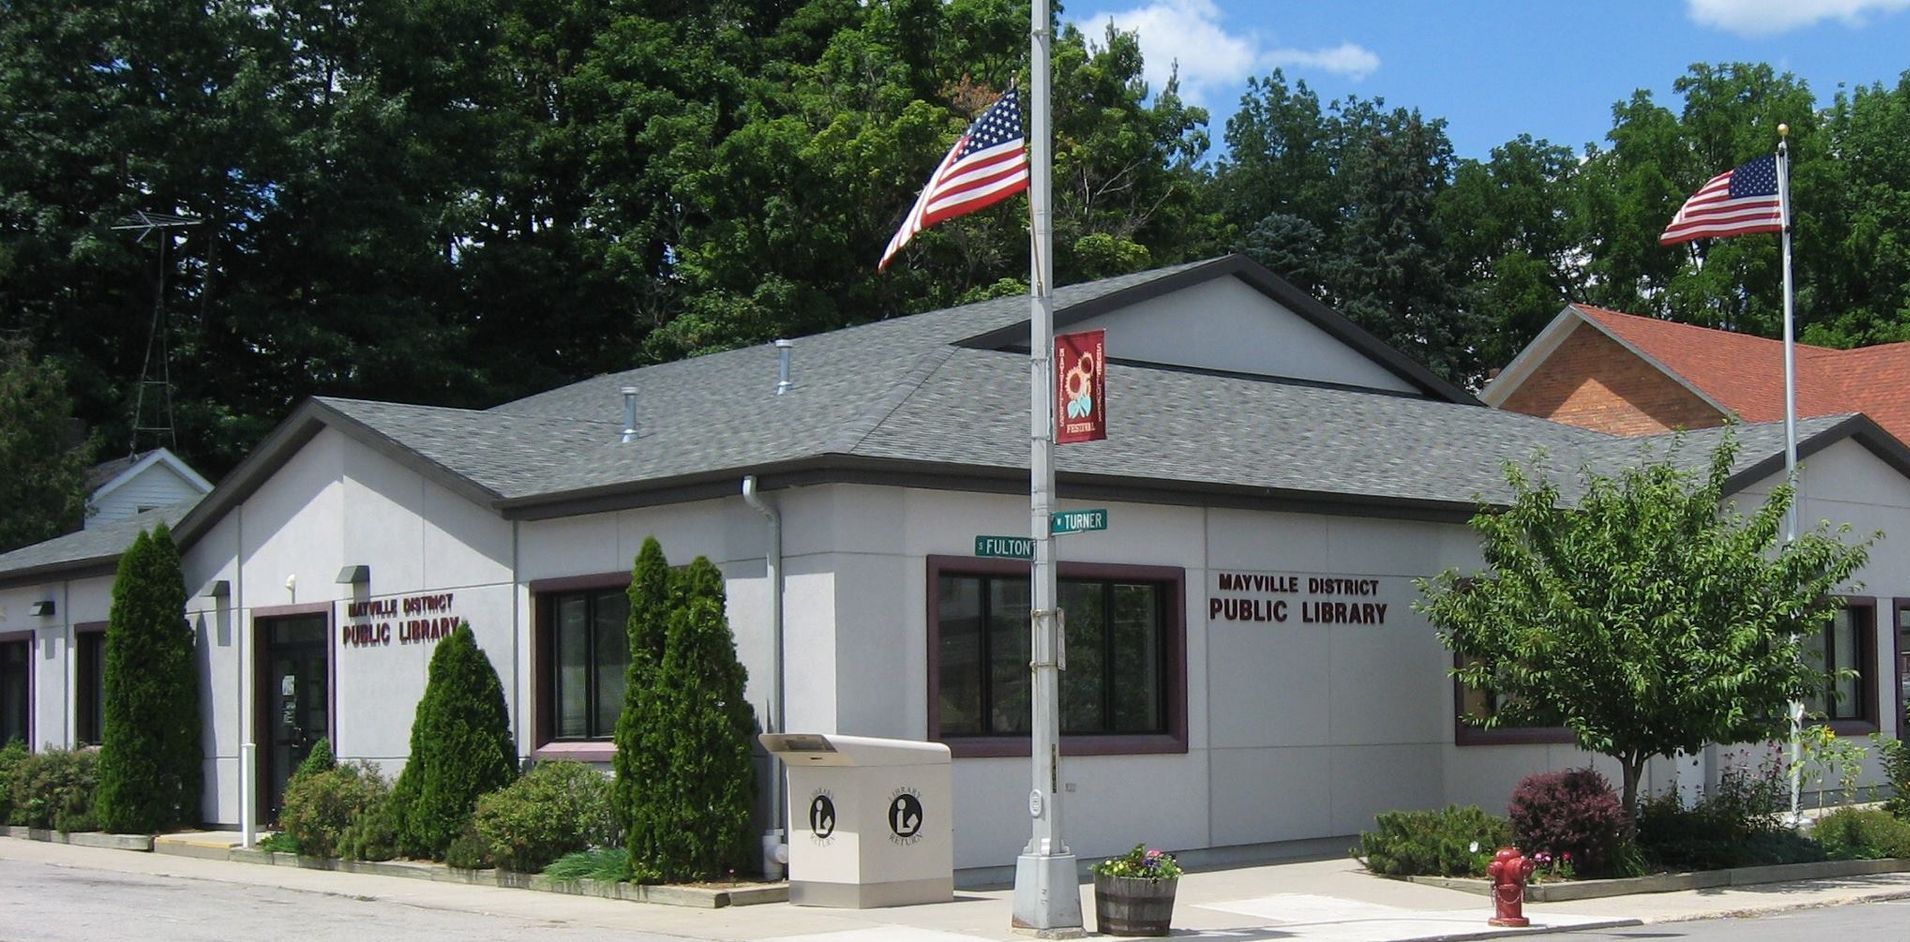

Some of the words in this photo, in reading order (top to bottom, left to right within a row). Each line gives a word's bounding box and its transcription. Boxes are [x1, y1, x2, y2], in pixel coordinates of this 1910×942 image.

[1066, 422, 1096, 434] FESTIVAL
[1064, 512, 1102, 530] TURNER
[978, 541, 983, 550] S
[986, 539, 1030, 555] FULTON
[1219, 573, 1299, 593] MAYVILLE
[1308, 577, 1379, 596] DISTRICT
[348, 599, 398, 618] MAYVILLE
[403, 593, 454, 614] DISTRICT
[1209, 598, 1288, 623] PUBLIC
[1302, 601, 1387, 625] LIBRARY
[342, 622, 391, 646] PUBLIC
[398, 616, 460, 642] LIBRARY
[888, 786, 923, 801] LIBRARY
[888, 832, 923, 847] RETURN
